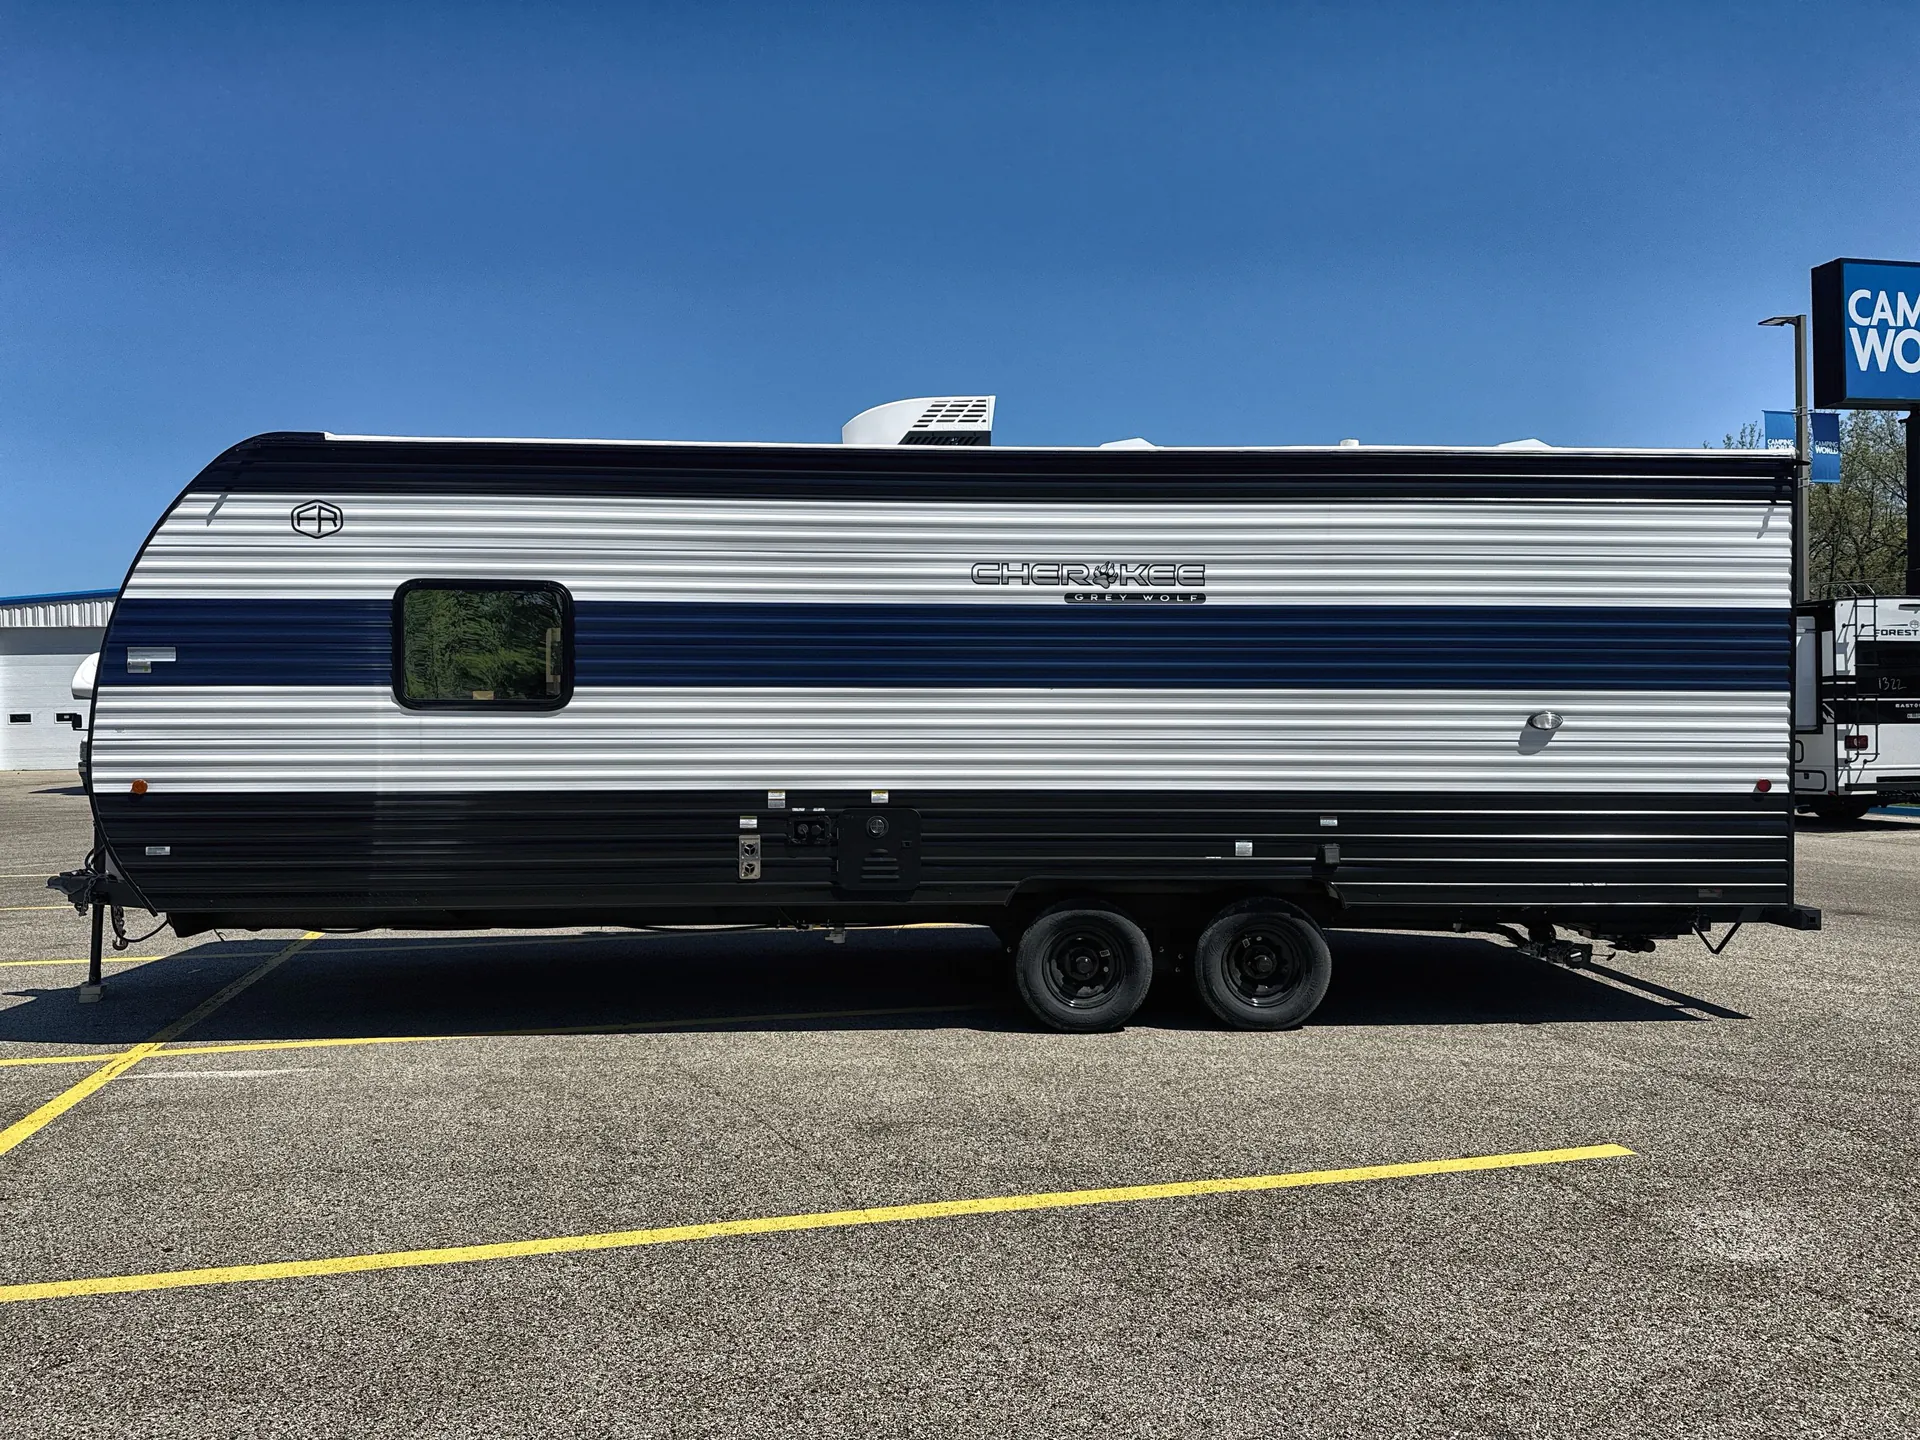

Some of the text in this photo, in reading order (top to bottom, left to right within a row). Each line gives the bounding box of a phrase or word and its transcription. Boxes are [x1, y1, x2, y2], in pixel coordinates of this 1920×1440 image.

[1848, 289, 1920, 327] CAM
[1848, 327, 1920, 374] WO
[1767, 438, 1794, 446] CAMPING
[1815, 440, 1839, 448] CAMPING
[1814, 445, 1839, 455] WORLD
[296, 504, 338, 534] FR
[1074, 593, 1198, 602] GREY WOLF
[1878, 677, 1908, 690] 1322
